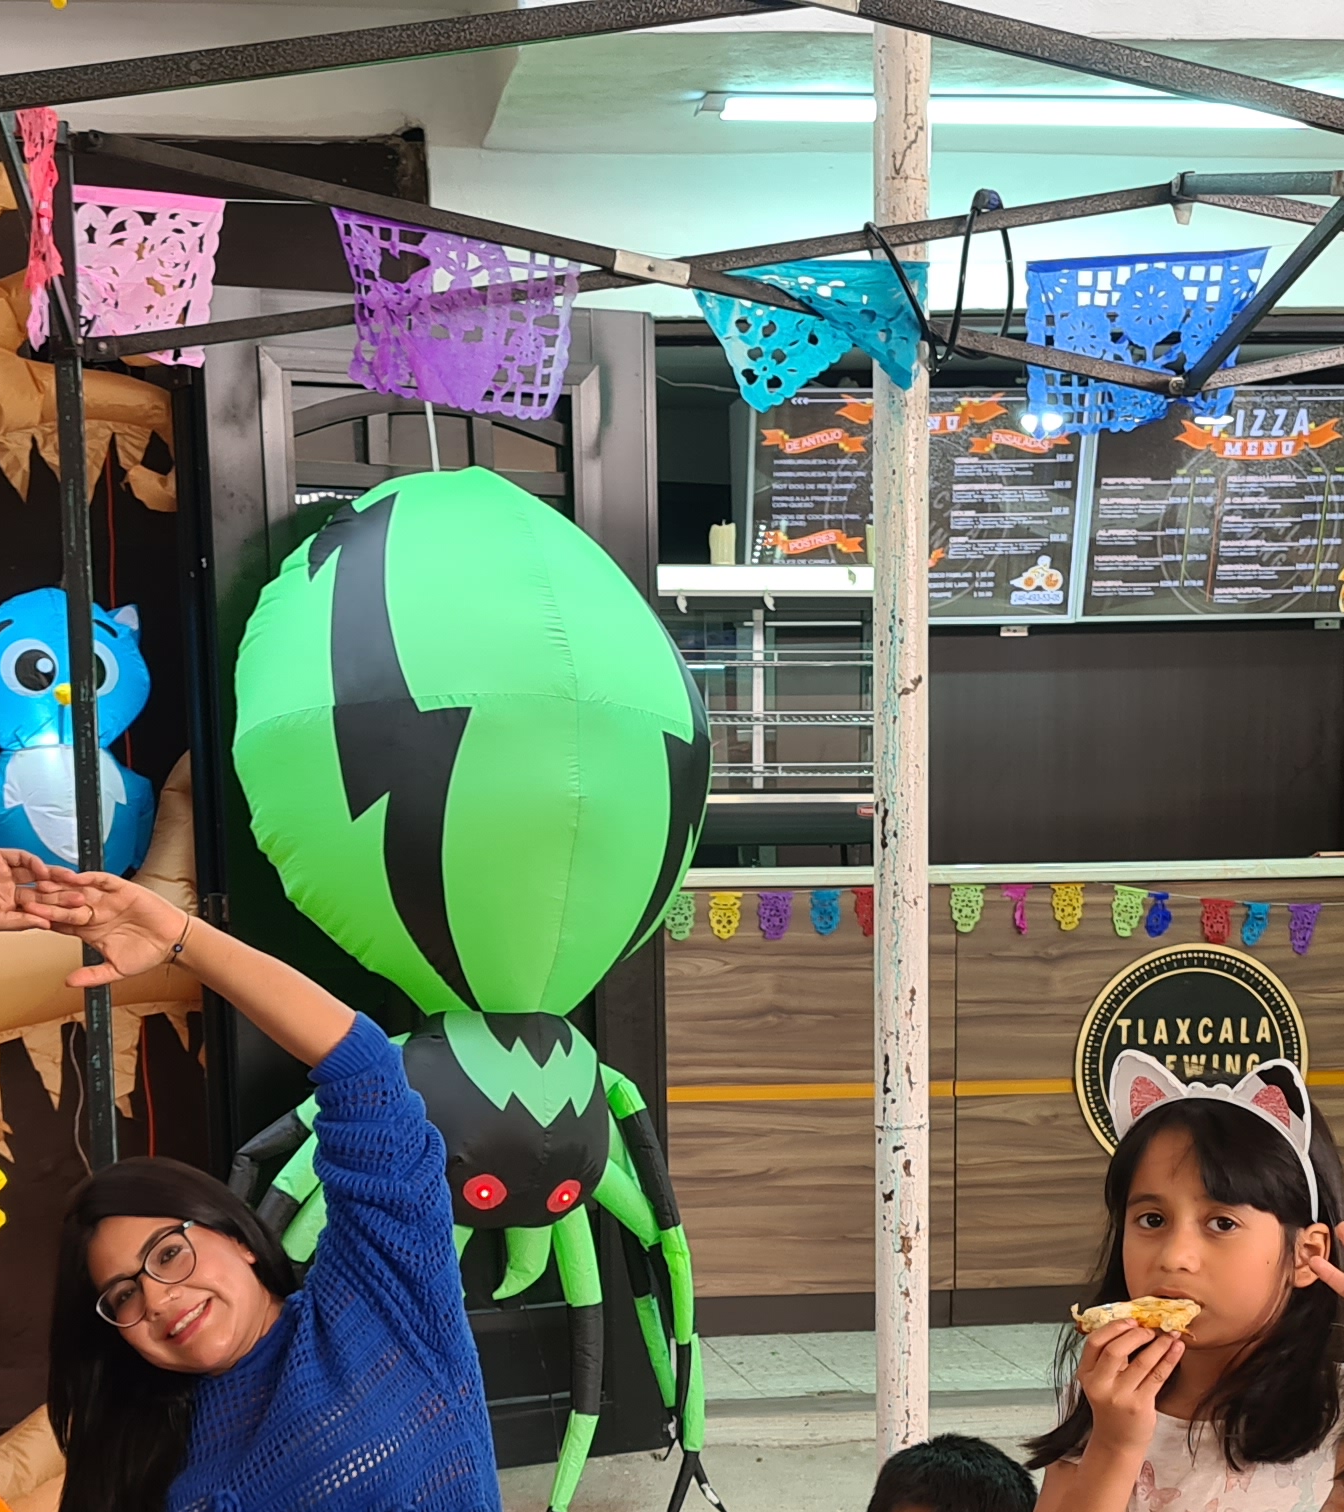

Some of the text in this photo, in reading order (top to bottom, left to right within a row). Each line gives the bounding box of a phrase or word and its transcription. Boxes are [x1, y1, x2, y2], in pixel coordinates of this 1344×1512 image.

[927, 415, 960, 431] NU
[785, 430, 843, 452] DE ANTOJO
[992, 432, 1054, 452] ENSALADAS
[1224, 440, 1296, 456] MENU
[788, 531, 837, 551] POSTRES
[1116, 1016, 1272, 1045] TLAXCALA
[1164, 1052, 1261, 1078] EWING
